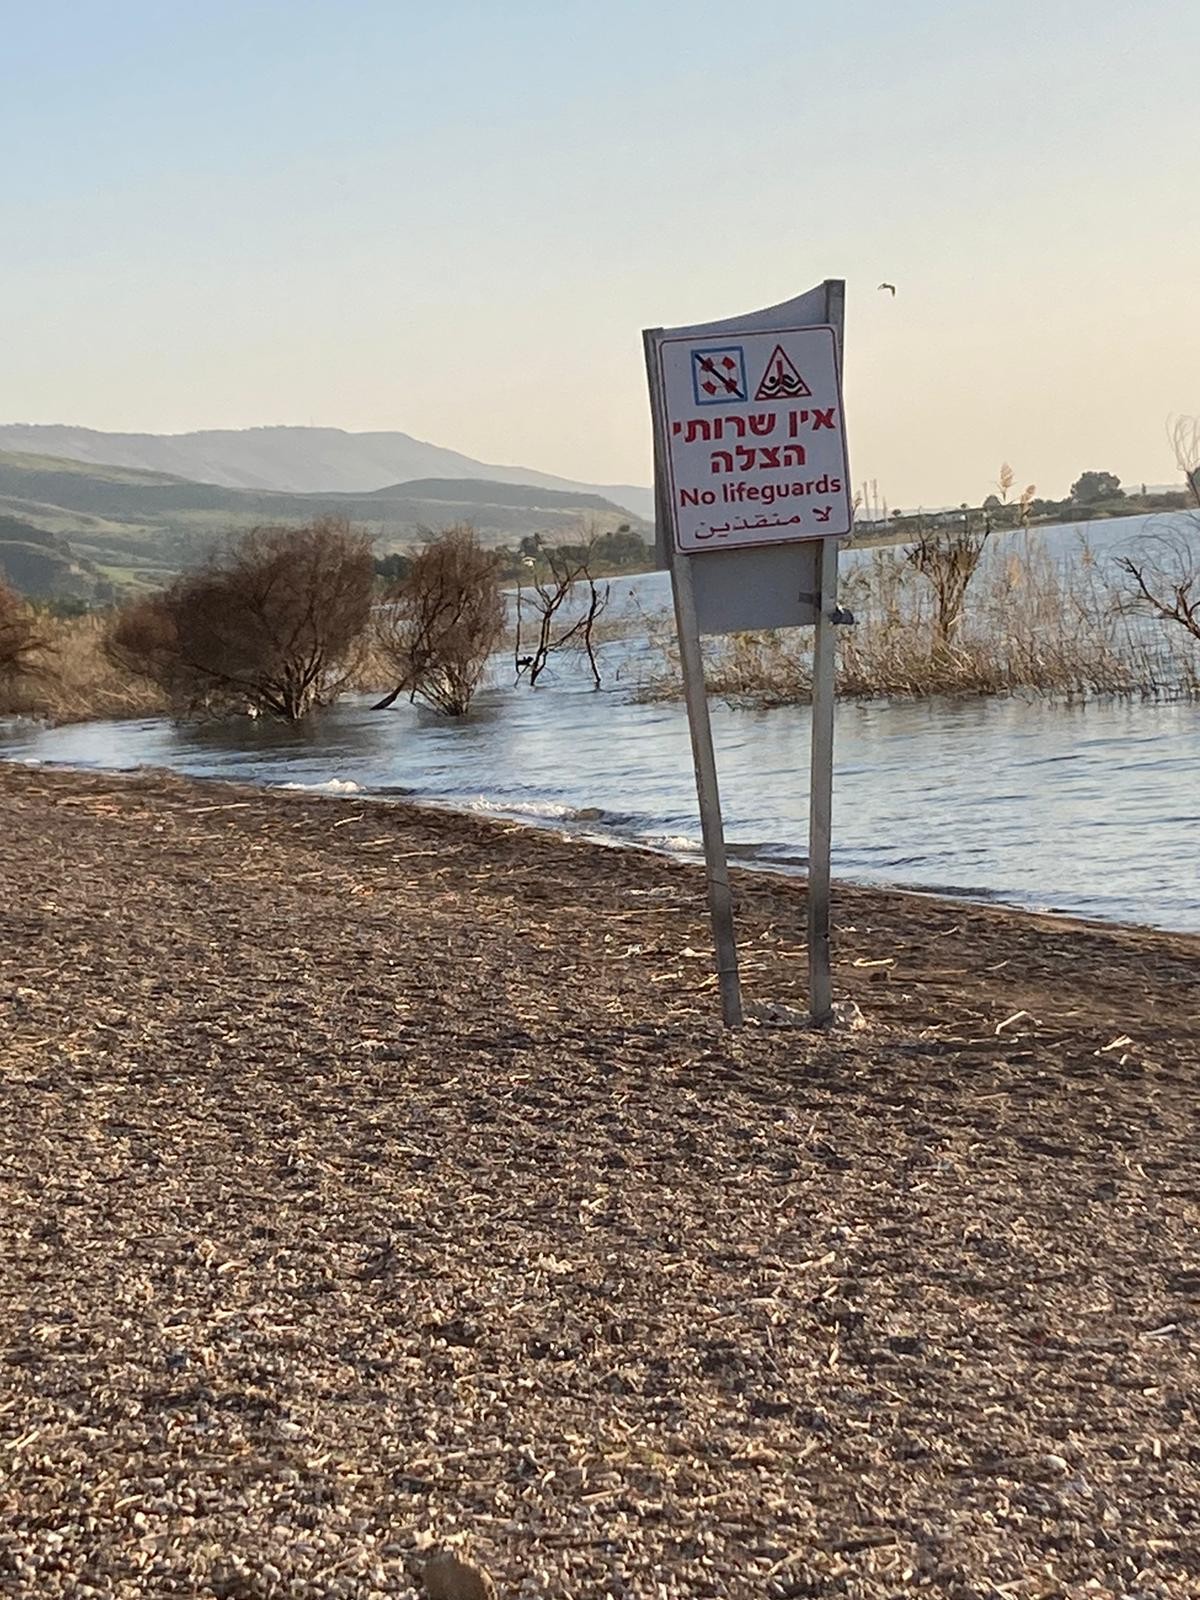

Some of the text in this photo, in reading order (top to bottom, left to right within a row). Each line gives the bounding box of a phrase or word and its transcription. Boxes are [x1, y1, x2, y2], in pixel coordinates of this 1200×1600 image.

[672, 408, 836, 443] אין שרותי
[710, 444, 806, 474] הצלה
[680, 474, 842, 507] No lifeguards
[812, 505, 833, 522] لا
